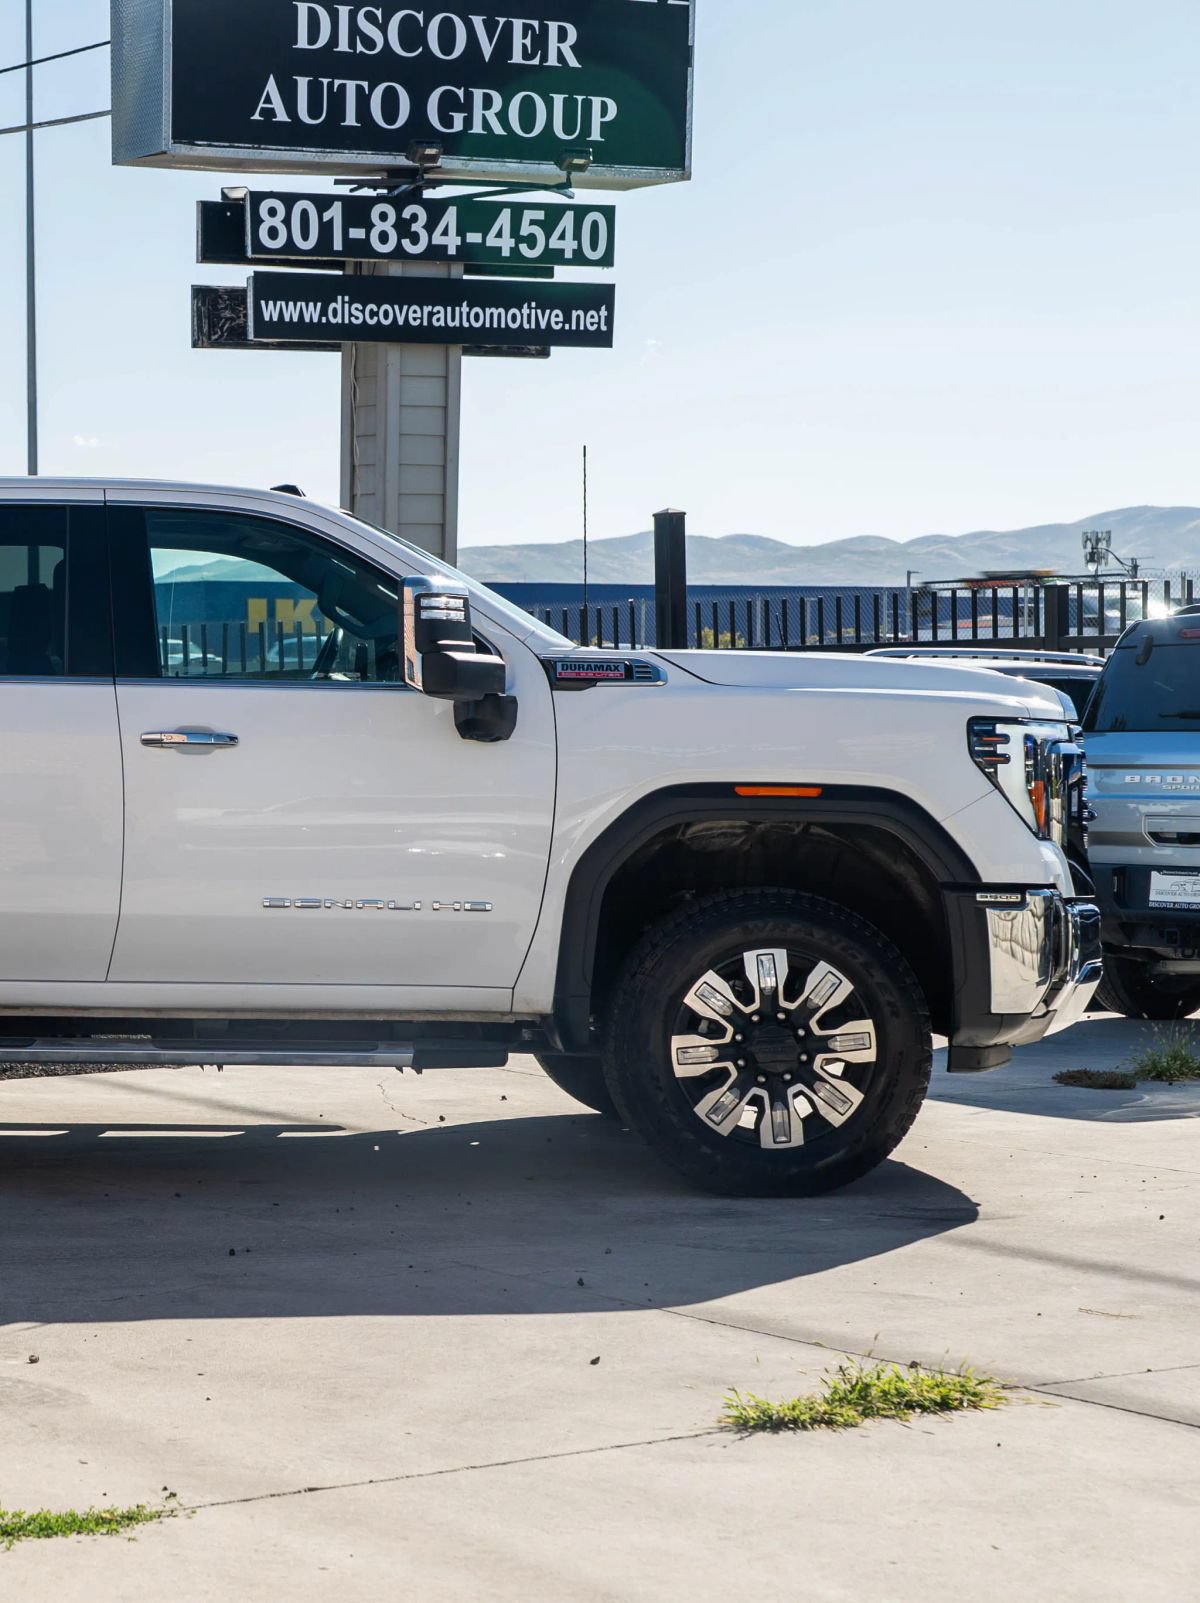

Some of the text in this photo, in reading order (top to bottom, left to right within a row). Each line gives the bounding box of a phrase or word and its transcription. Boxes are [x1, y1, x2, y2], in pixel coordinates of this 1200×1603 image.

[293, 2, 582, 68] DISCOVER
[250, 74, 618, 142] AUTO GROUP
[258, 199, 608, 261] 801-834-4540
[260, 295, 608, 331] www.discoverautomotive.net
[561, 663, 620, 672] DURAMAX
[263, 897, 494, 912] DENALI HD
